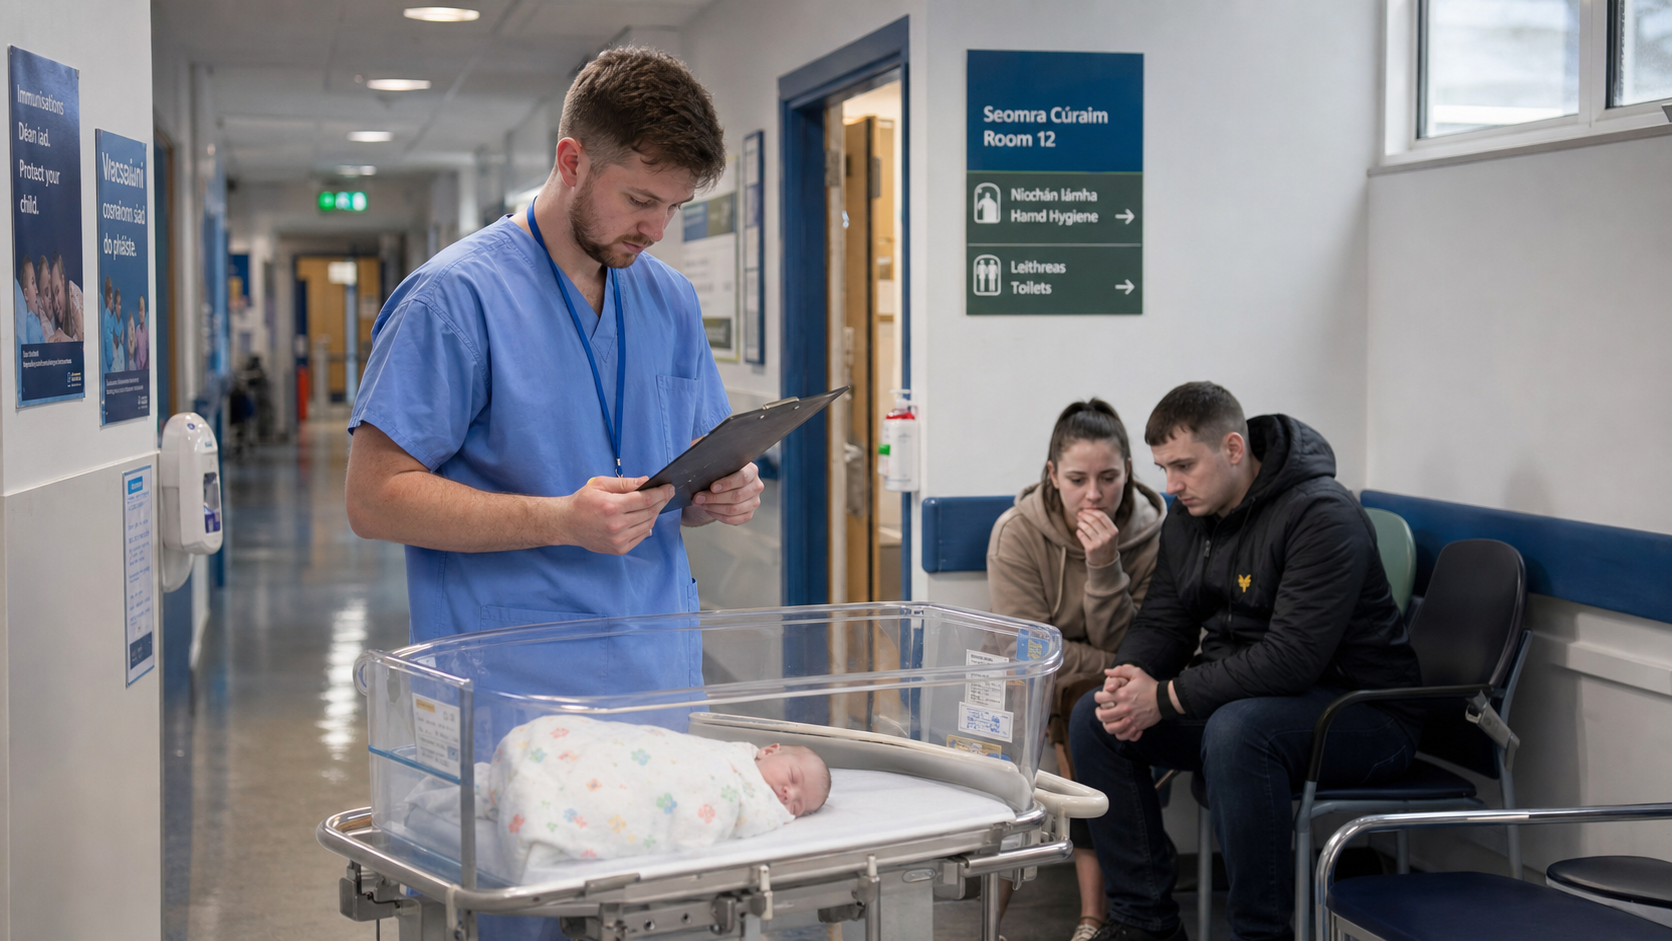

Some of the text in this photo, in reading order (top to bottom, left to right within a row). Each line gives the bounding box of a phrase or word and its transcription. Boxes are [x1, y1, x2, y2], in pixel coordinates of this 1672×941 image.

[17, 84, 64, 115] Immunisations
[984, 106, 1108, 123] Seomra Cúraim
[984, 130, 1056, 147] Room 12
[19, 159, 60, 187] Protect your
[20, 194, 39, 215] child.
[1049, 209, 1098, 226] Hygiene
[104, 233, 112, 254] do
[1011, 261, 1066, 273] Leithreas
[1011, 281, 1052, 294] Toilets
